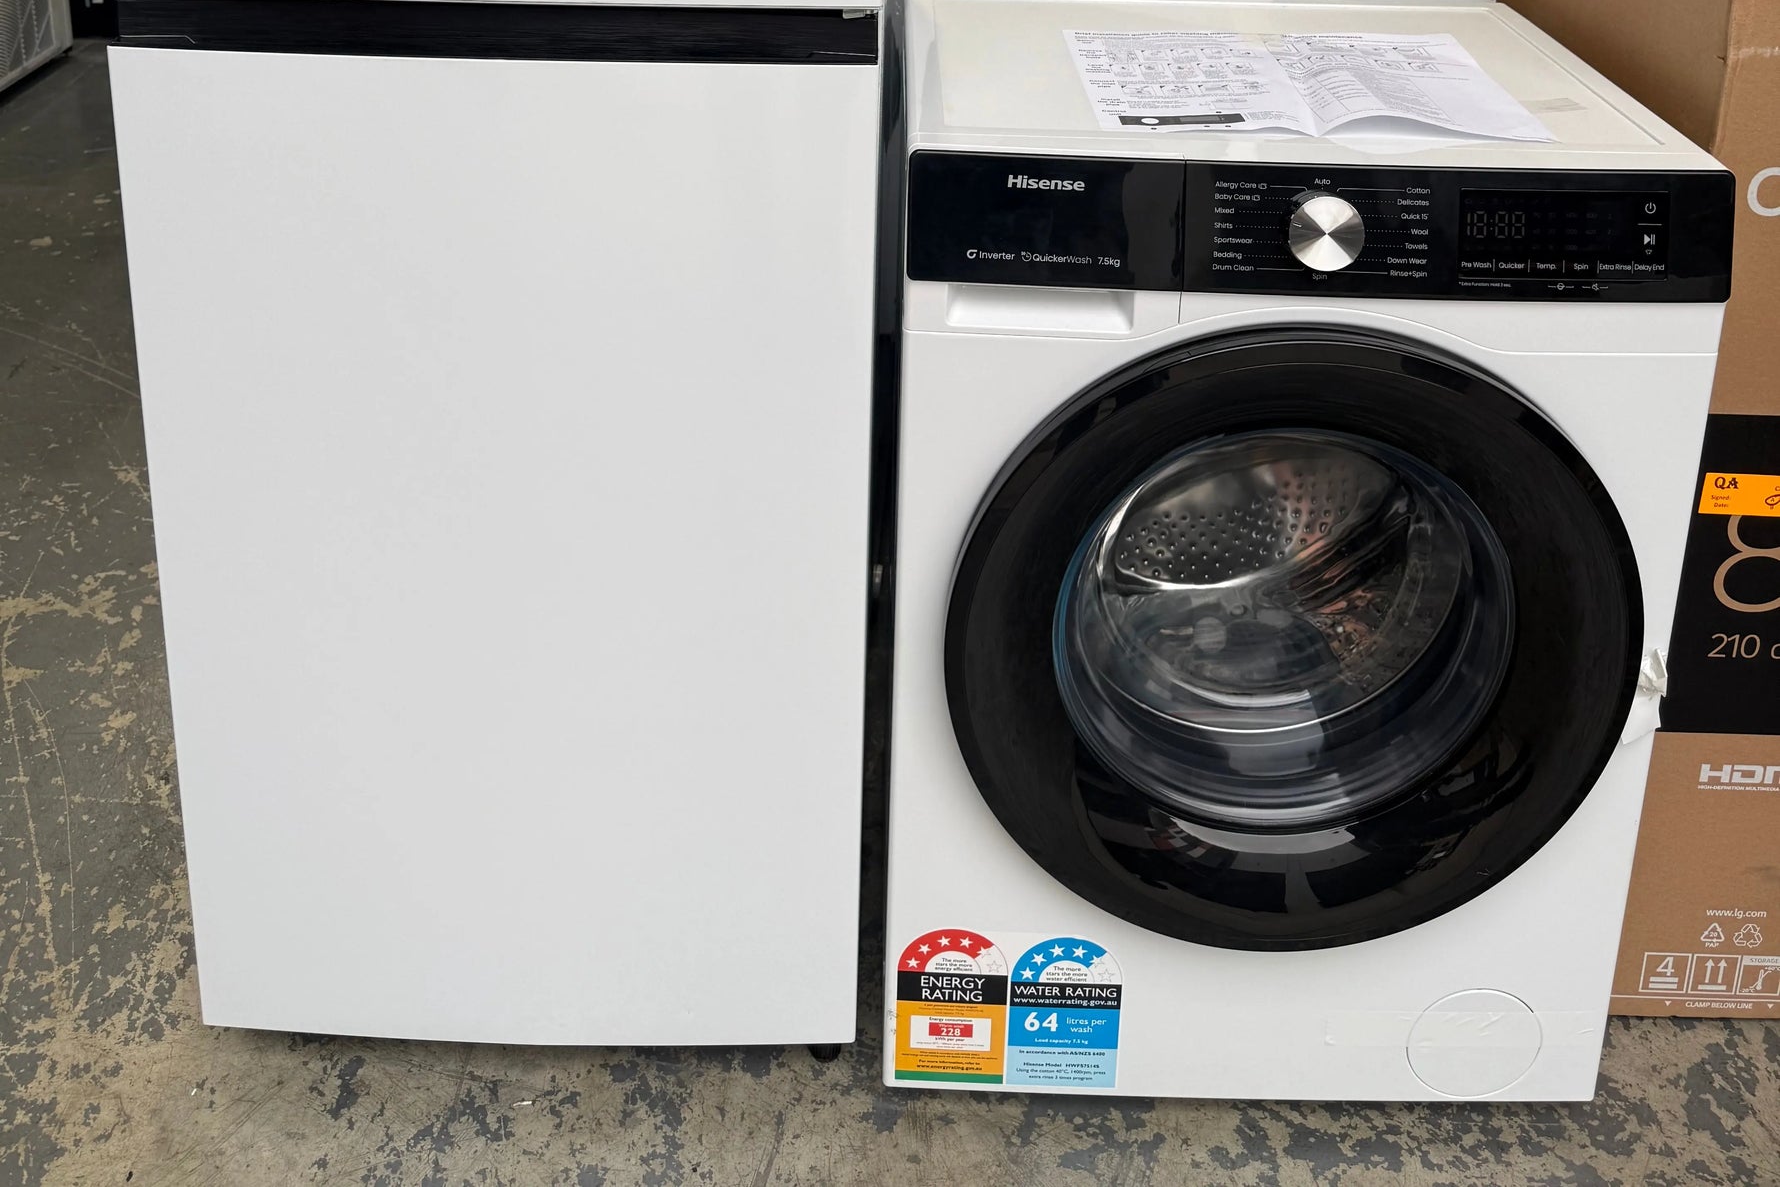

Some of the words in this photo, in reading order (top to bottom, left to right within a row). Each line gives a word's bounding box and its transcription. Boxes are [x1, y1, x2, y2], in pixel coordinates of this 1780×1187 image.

[1007, 174, 1086, 192] Hisense
[1214, 181, 1239, 190] Allergy
[1240, 181, 1257, 189] Care
[1314, 177, 1331, 186] Auto
[1406, 187, 1431, 195] Cotton
[1214, 193, 1233, 202] Baby
[1233, 193, 1251, 201] Care
[1397, 198, 1430, 207] Delicates
[1214, 206, 1235, 215] Mixed
[1400, 212, 1420, 221] Quick
[1214, 221, 1233, 230] Shirts
[1410, 227, 1429, 236] Wool
[1213, 236, 1253, 245] Sportswear
[1404, 242, 1428, 251] Towels
[978, 250, 1016, 261] Inverter
[1213, 250, 1243, 260] Bedding
[1032, 252, 1092, 266] QuickerWash
[1097, 256, 1121, 268] 7.5kg
[1387, 256, 1406, 265] Down
[1407, 257, 1428, 265] Wear
[1212, 263, 1233, 272] Drum
[1233, 264, 1255, 272] Clean
[1461, 261, 1472, 269] Pre
[1472, 261, 1492, 269] Wash
[1498, 261, 1525, 269] Quicker
[1536, 262, 1557, 271] Temp.
[1573, 262, 1589, 272] Spin
[1599, 263, 1615, 271] Extra
[1634, 263, 1652, 272] Delay
[1652, 264, 1665, 272] End
[1312, 272, 1328, 281] Spin
[1389, 269, 1428, 279] Rinse+Spin
[1714, 476, 1739, 490] QA
[1707, 633, 1761, 659] 210
[1706, 908, 1767, 919] www.lg.com
[1656, 956, 1675, 976] 4
[920, 975, 986, 990] ENERGY
[921, 988, 983, 1002] RATING
[1014, 985, 1061, 997] WATER
[1065, 986, 1118, 998] RATING
[1013, 997, 1118, 1007] www.waterrating.gov.au
[1685, 1001, 1711, 1009] CLAMP
[1024, 1011, 1059, 1032] 64
[1066, 1017, 1089, 1025] litres
[1091, 1018, 1107, 1027] per
[941, 1027, 961, 1036] 228
